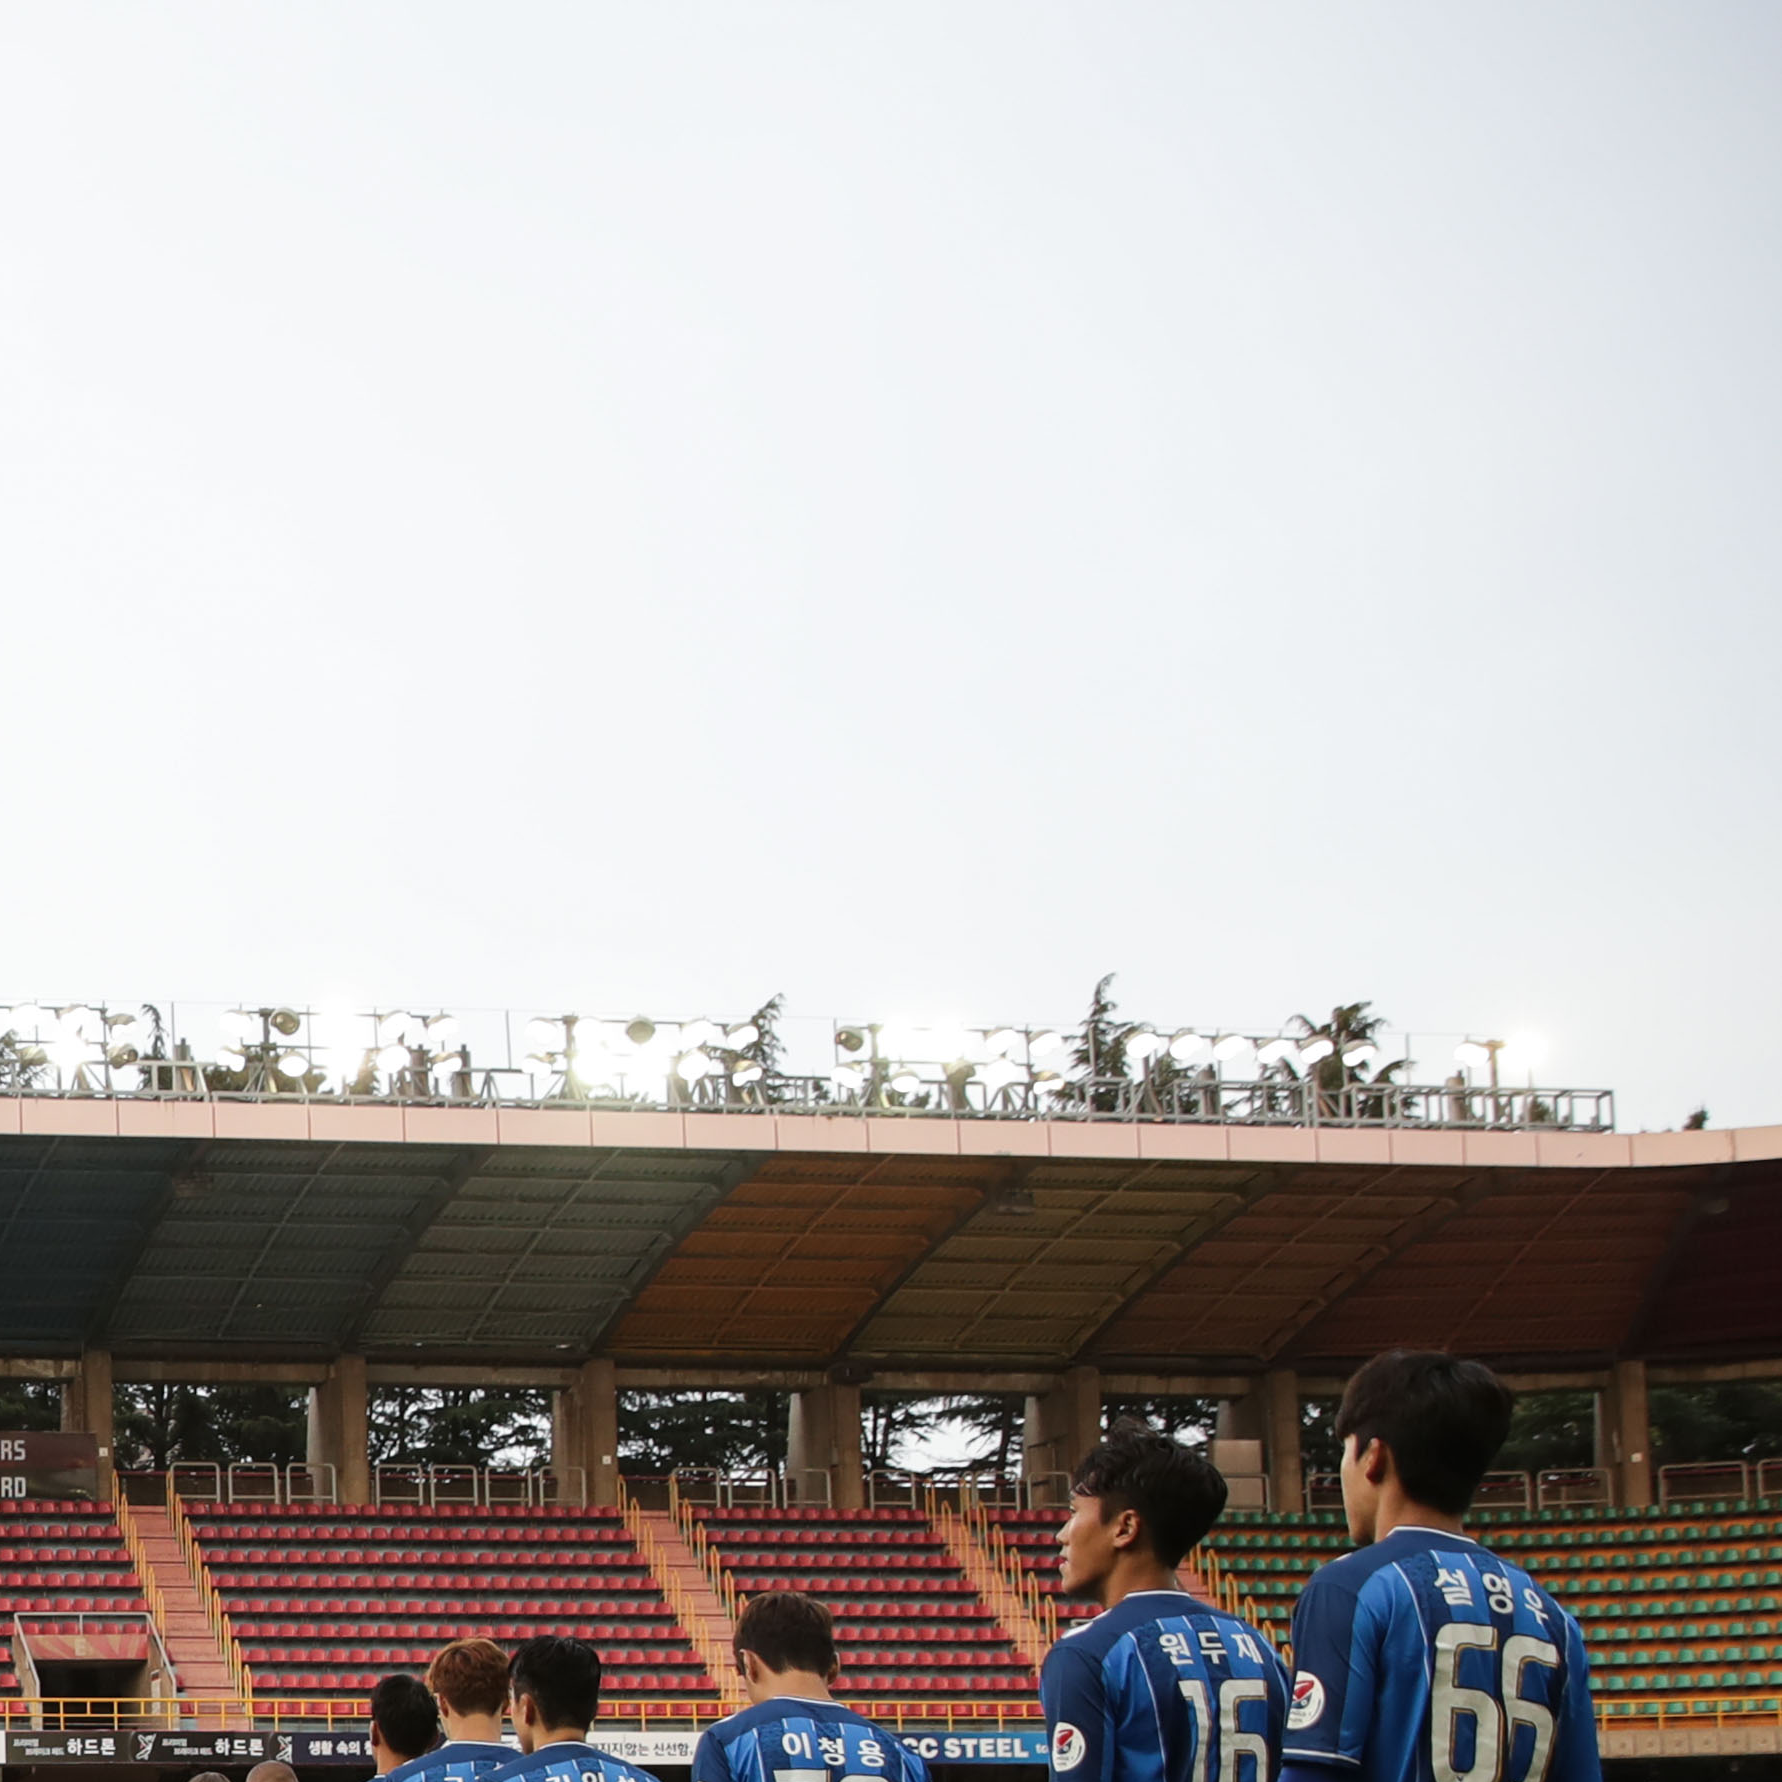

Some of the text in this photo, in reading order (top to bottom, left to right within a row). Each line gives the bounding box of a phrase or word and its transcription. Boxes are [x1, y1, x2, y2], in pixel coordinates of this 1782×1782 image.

[1435, 1567, 1548, 1625] 설영우
[1157, 1631, 1264, 1666] 원두재
[67, 1738, 116, 1756] 하드론
[215, 1738, 264, 1756] 하드론
[308, 1741, 333, 1756] 생활
[336, 1741, 360, 1755] 속의
[781, 1732, 887, 1768] 이청용
[944, 1737, 1030, 1759] STEEL
